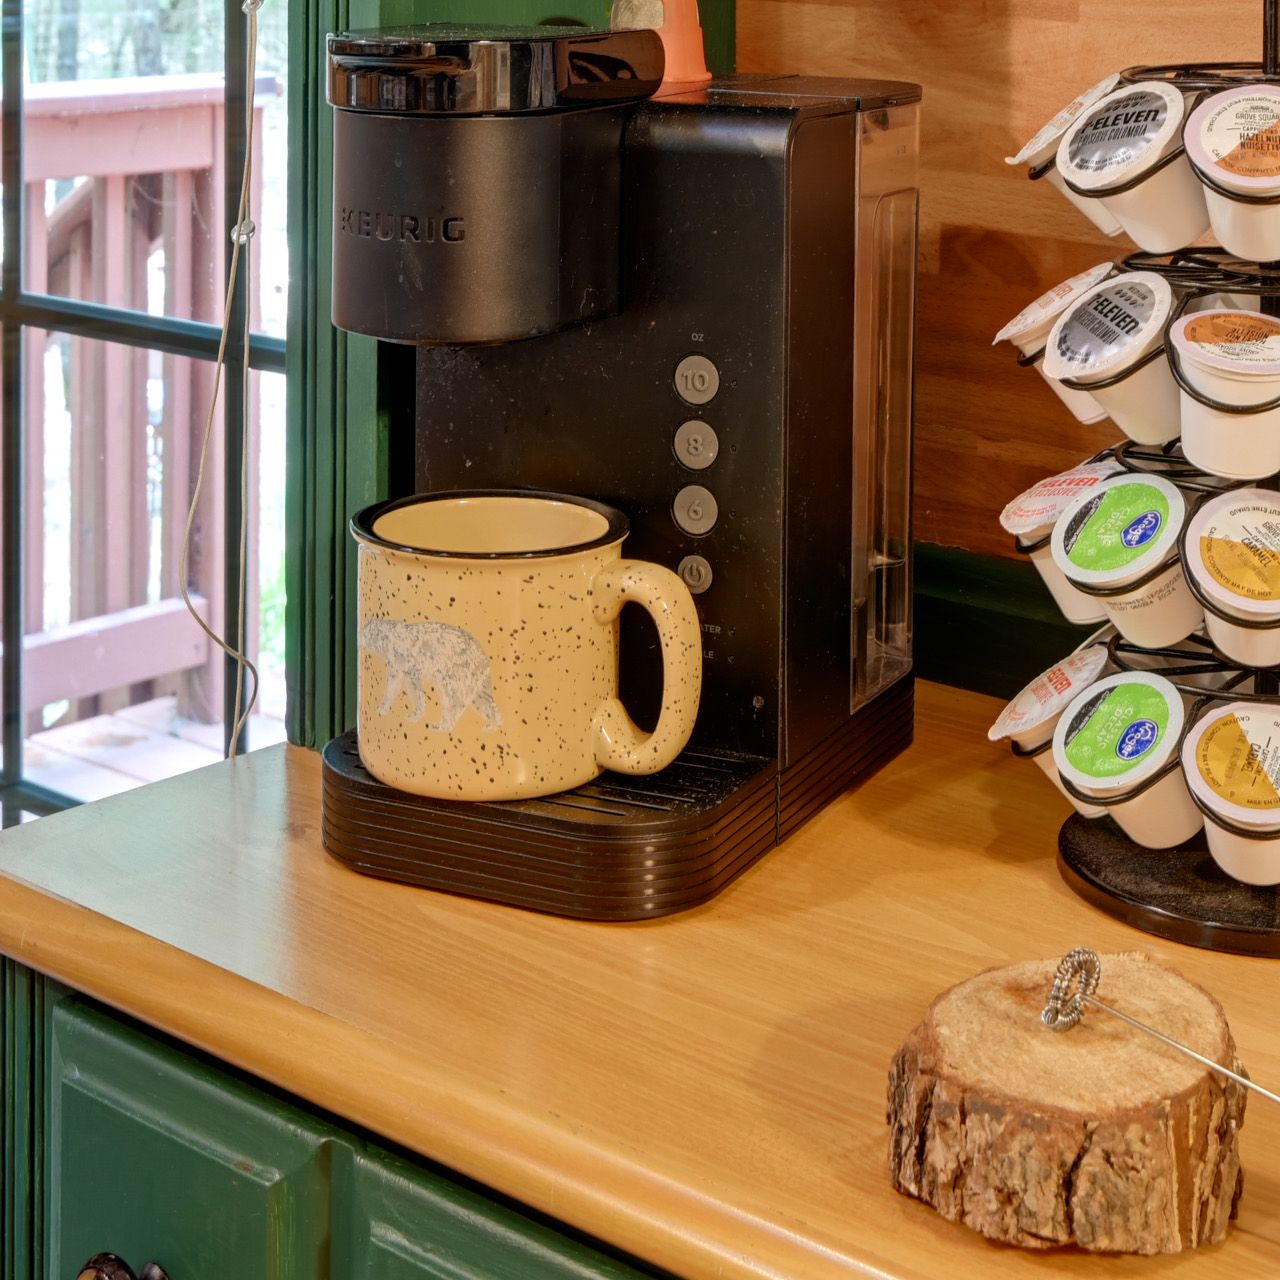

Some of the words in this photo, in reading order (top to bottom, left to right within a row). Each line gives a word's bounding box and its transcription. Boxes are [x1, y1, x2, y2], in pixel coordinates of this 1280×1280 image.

[1240, 132, 1280, 144] HAZELNUT
[1240, 141, 1280, 150] NOISETTE
[342, 207, 466, 243] KEURIG
[681, 370, 710, 392] 10
[687, 434, 703, 456] 8
[687, 499, 703, 520] 6
[1127, 512, 1156, 546] Kroger
[1262, 521, 1280, 541] GROVE
[1241, 537, 1273, 568] CARAMEL
[1208, 555, 1231, 583] CONTENTS
[1231, 581, 1245, 590] MAY
[1246, 587, 1256, 595] BE
[1095, 708, 1122, 742] DECAF
[1098, 706, 1134, 749] CLASSIC
[1122, 722, 1153, 757] Kroger
